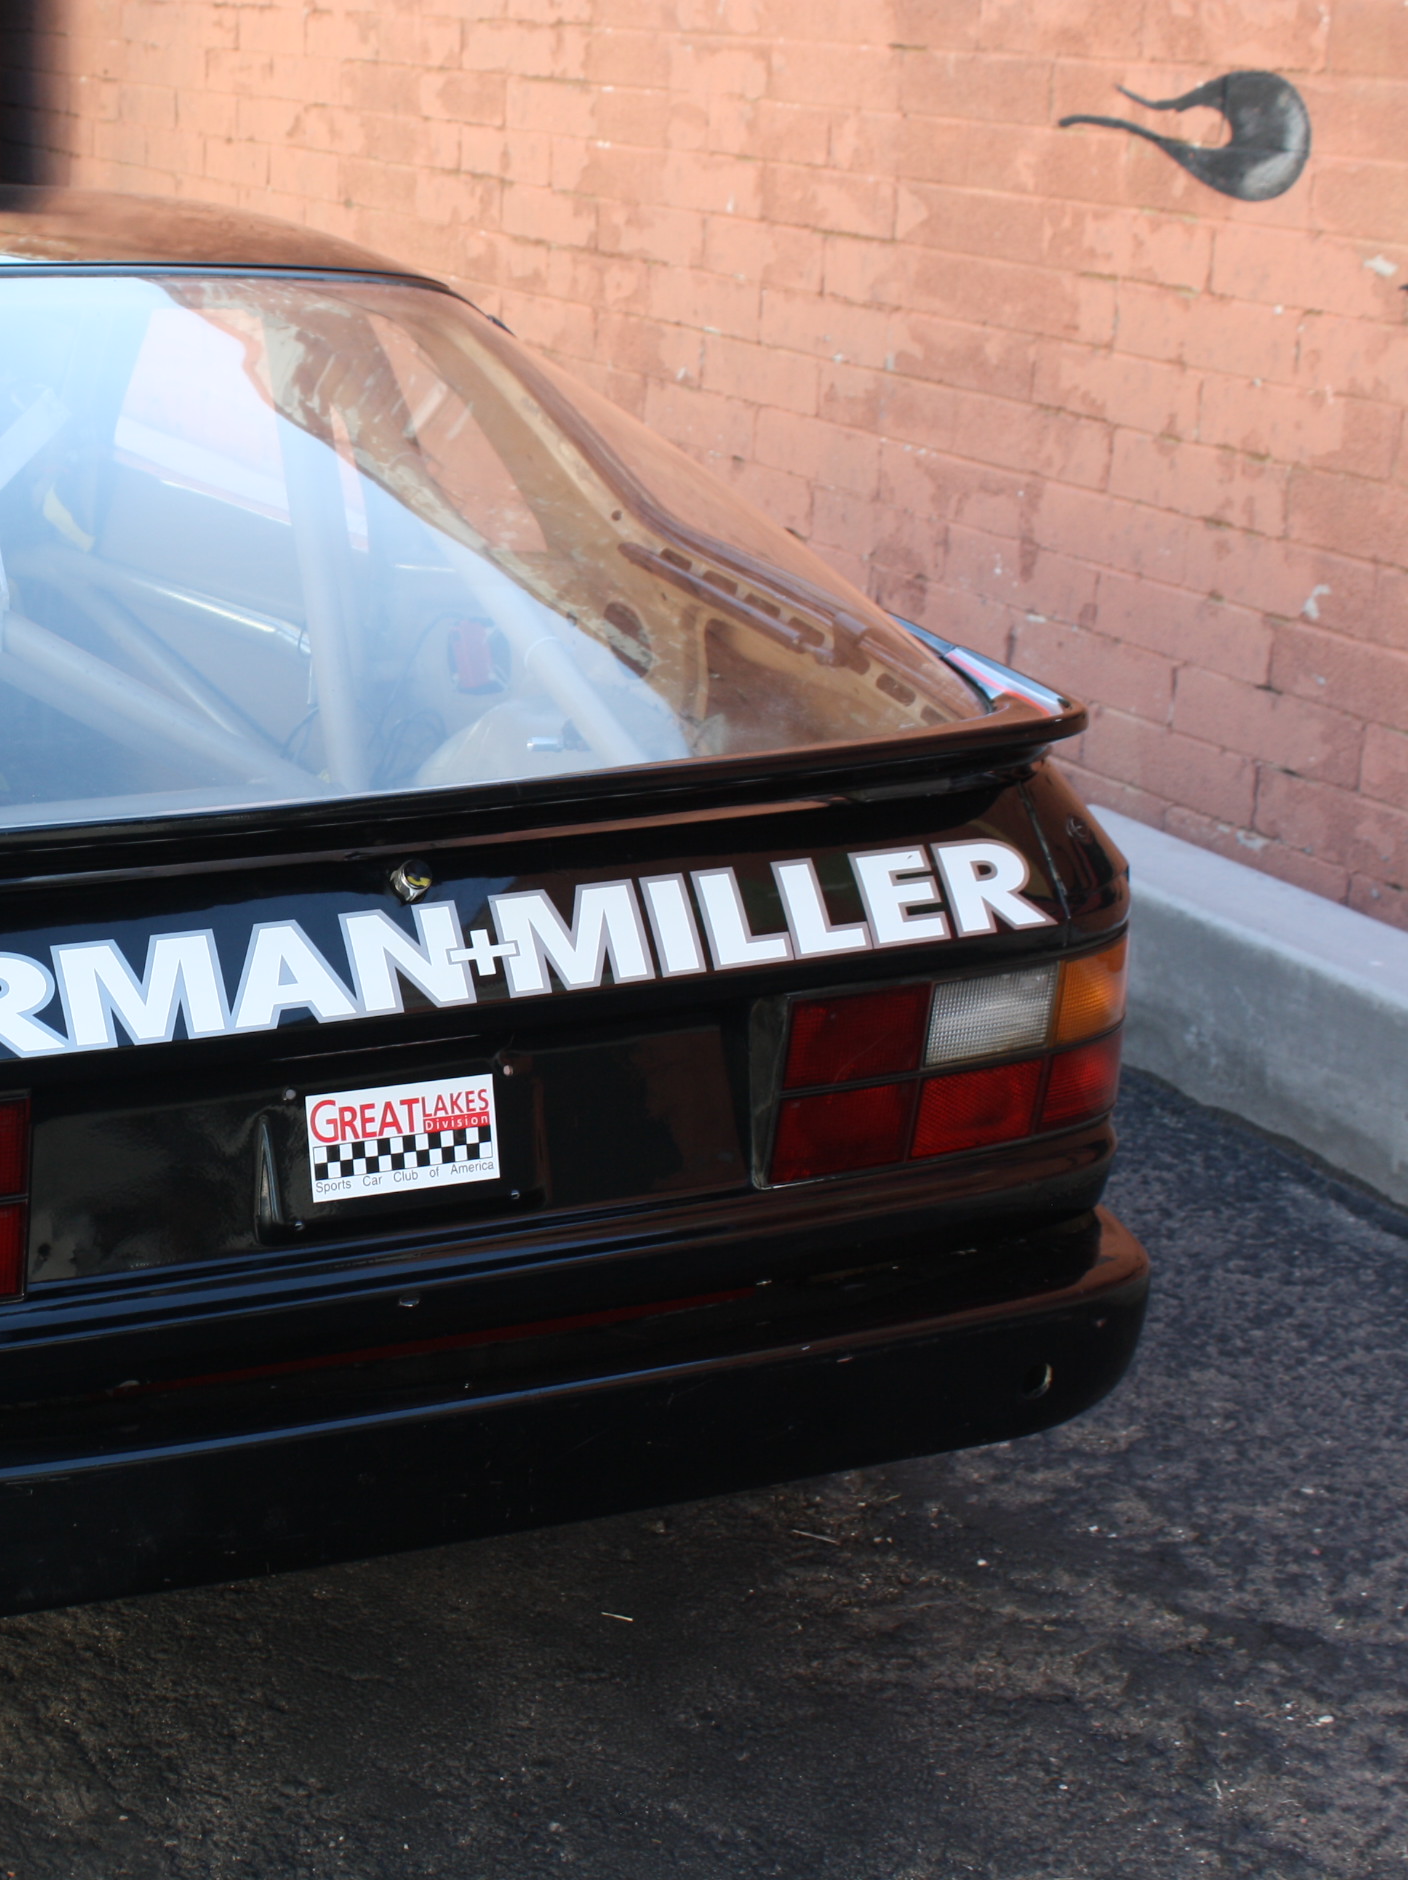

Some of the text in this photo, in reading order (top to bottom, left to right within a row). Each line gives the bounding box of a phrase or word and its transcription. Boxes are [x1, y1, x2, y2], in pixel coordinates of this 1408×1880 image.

[310, 1088, 489, 1143] GREAT LAKES
[425, 1115, 488, 1131] Division
[315, 1160, 494, 1194] Sports Car Club of America
